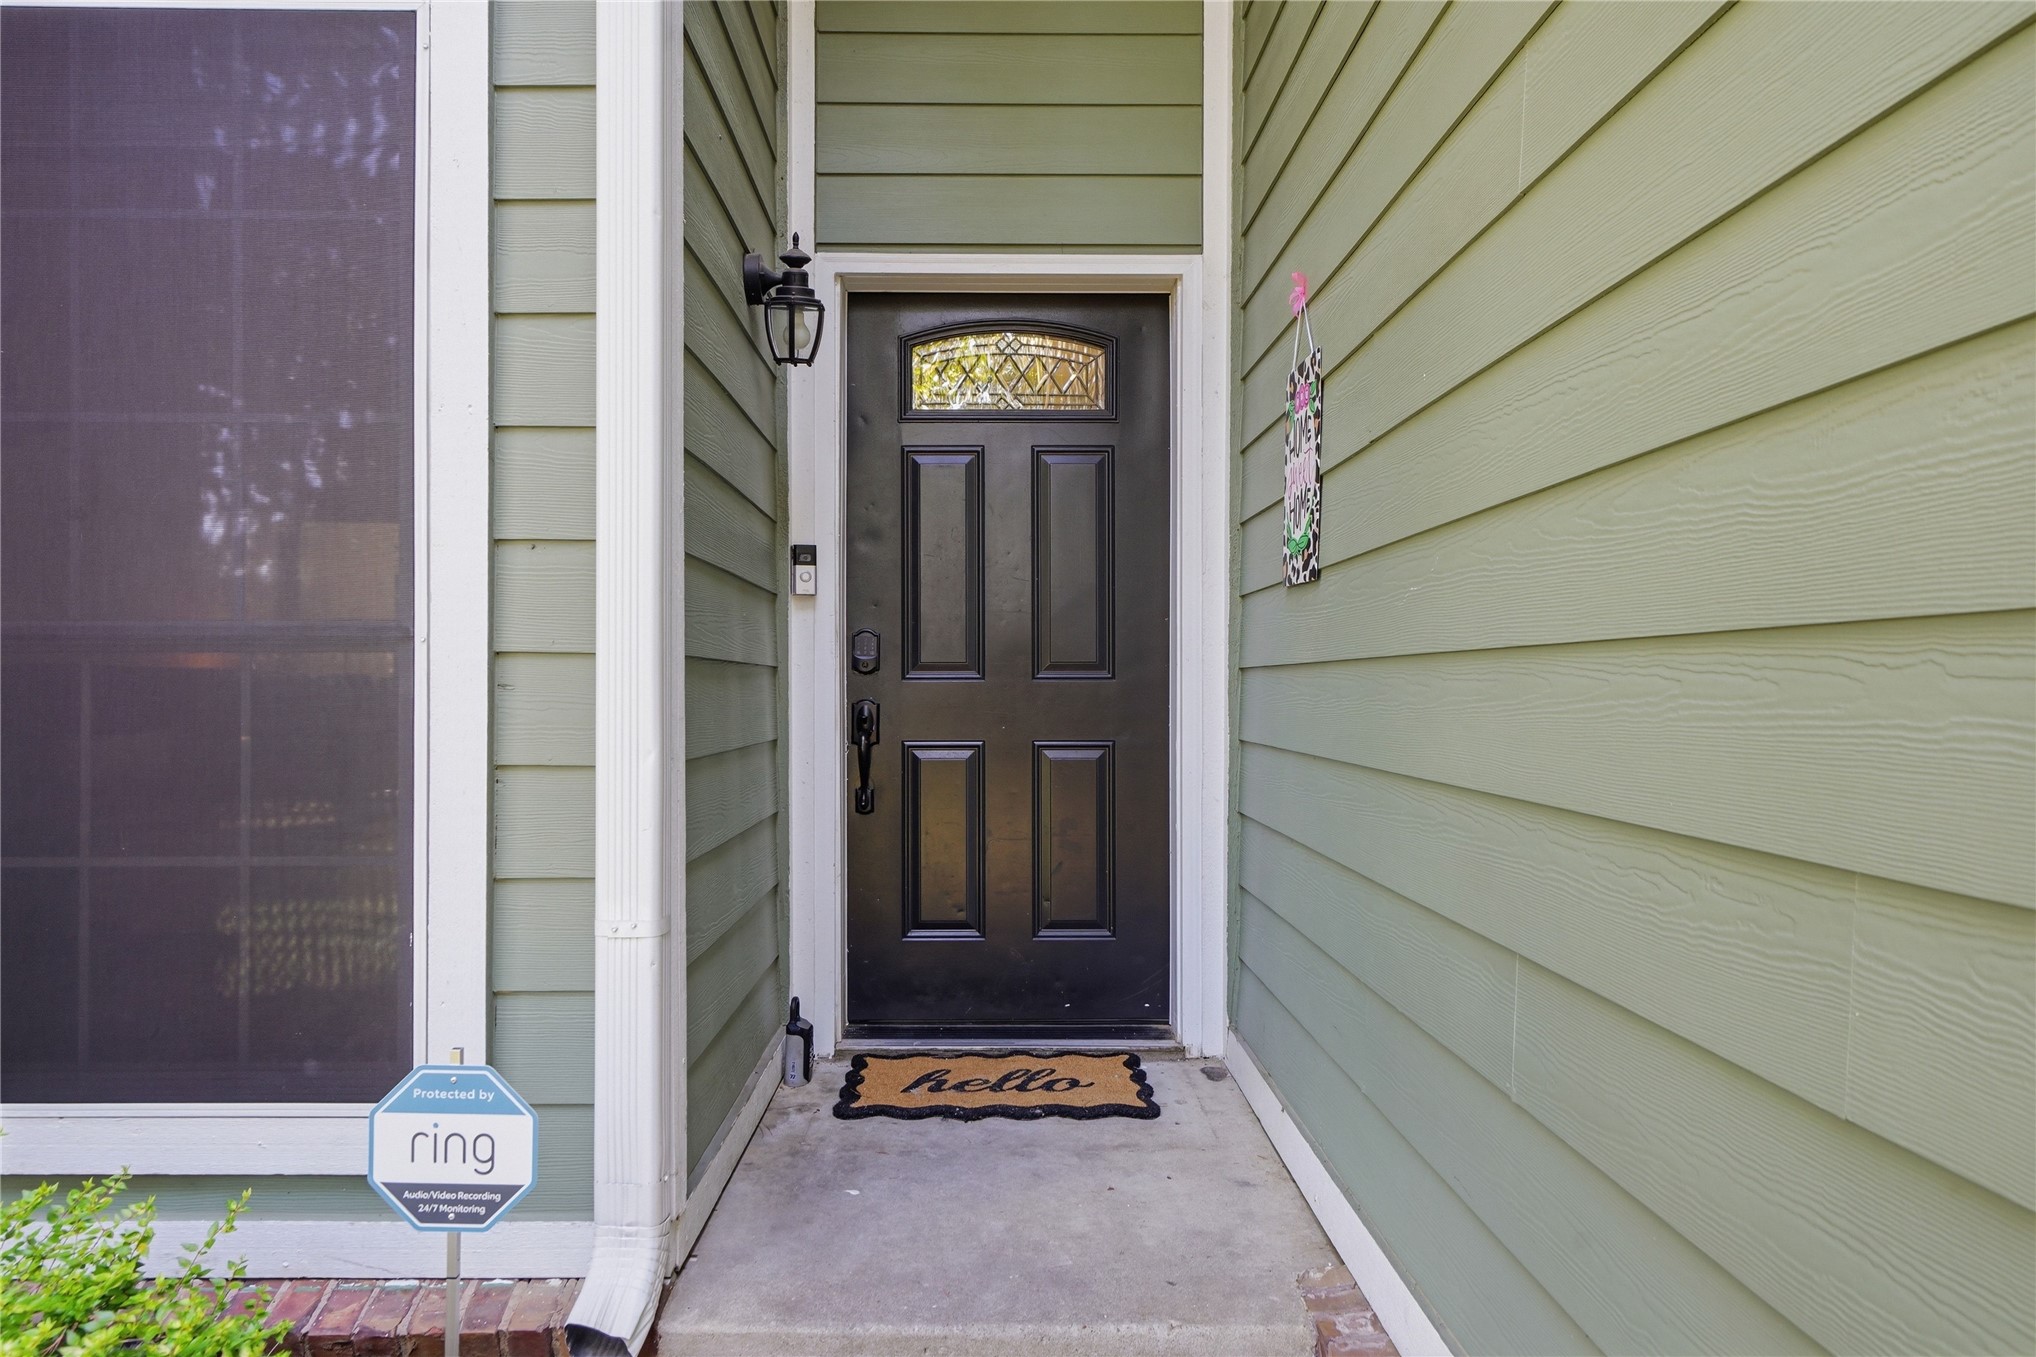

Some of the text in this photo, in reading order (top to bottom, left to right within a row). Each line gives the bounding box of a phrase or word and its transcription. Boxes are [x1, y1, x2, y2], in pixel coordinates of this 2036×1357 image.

[1289, 410, 1312, 463] HOME
[1289, 483, 1312, 534] HOME
[899, 1068, 1095, 1093] hello
[413, 1088, 495, 1102] Protected by
[411, 1122, 495, 1175] ring
[403, 1190, 501, 1202] Audio/Video Recording
[418, 1203, 486, 1215] 24/7 Monitoring
